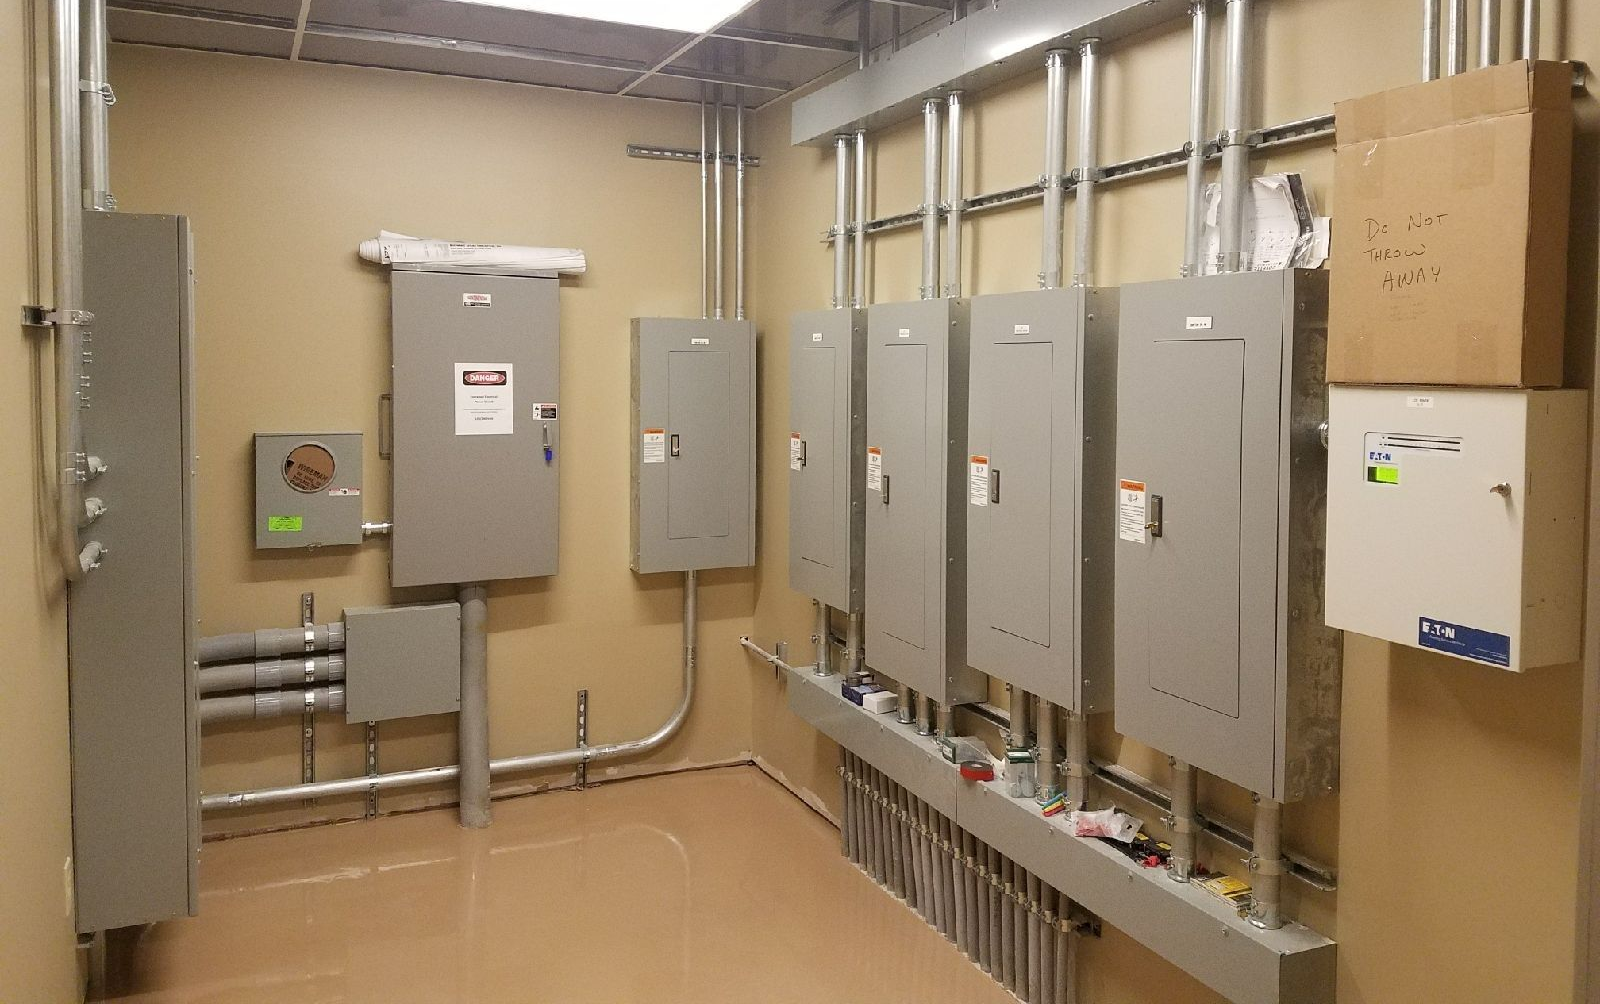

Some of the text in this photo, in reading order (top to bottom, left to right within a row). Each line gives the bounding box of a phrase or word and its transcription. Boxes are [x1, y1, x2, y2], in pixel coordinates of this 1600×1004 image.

[1363, 243, 1426, 264] THROW
[1383, 266, 1441, 294] AWAY
[470, 374, 499, 382] DANGER
